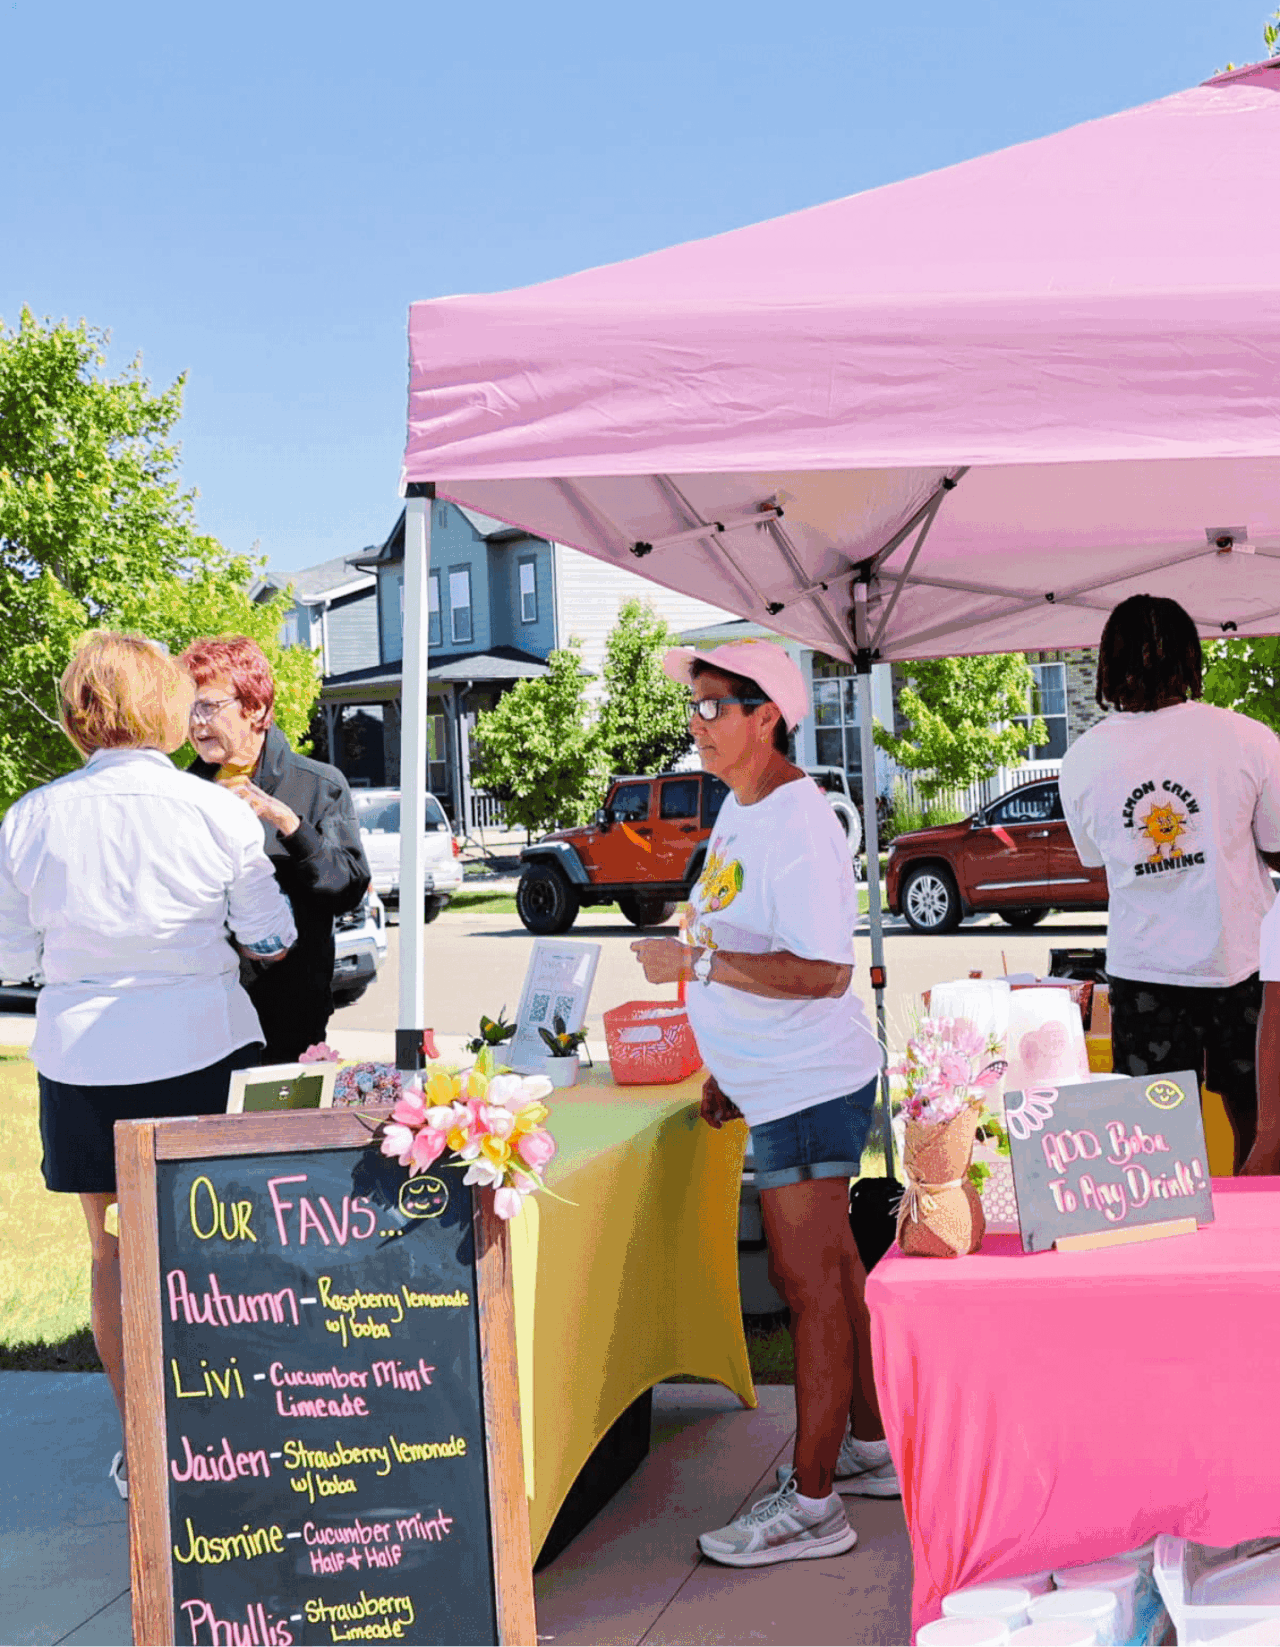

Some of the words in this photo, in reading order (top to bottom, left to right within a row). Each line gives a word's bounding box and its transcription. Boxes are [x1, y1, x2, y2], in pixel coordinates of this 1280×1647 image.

[1122, 780, 1156, 828] LEMON
[1162, 780, 1200, 814] CREW
[1134, 852, 1205, 876] SHINING
[1041, 1129, 1102, 1174] ADD
[1105, 1120, 1170, 1165] Boba
[1048, 1178, 1077, 1214] To
[1079, 1175, 1127, 1221] Any
[1122, 1159, 1207, 1208] Drink!
[402, 1284, 470, 1308] lemonade
[350, 1315, 392, 1338] boba
[269, 1362, 368, 1389] Cucumber
[275, 1390, 369, 1418] Limeade
[389, 1435, 467, 1463] lemonade
[315, 1474, 358, 1496] boba
[303, 1518, 390, 1545] Cucumber
[330, 1617, 405, 1642] Limeade
